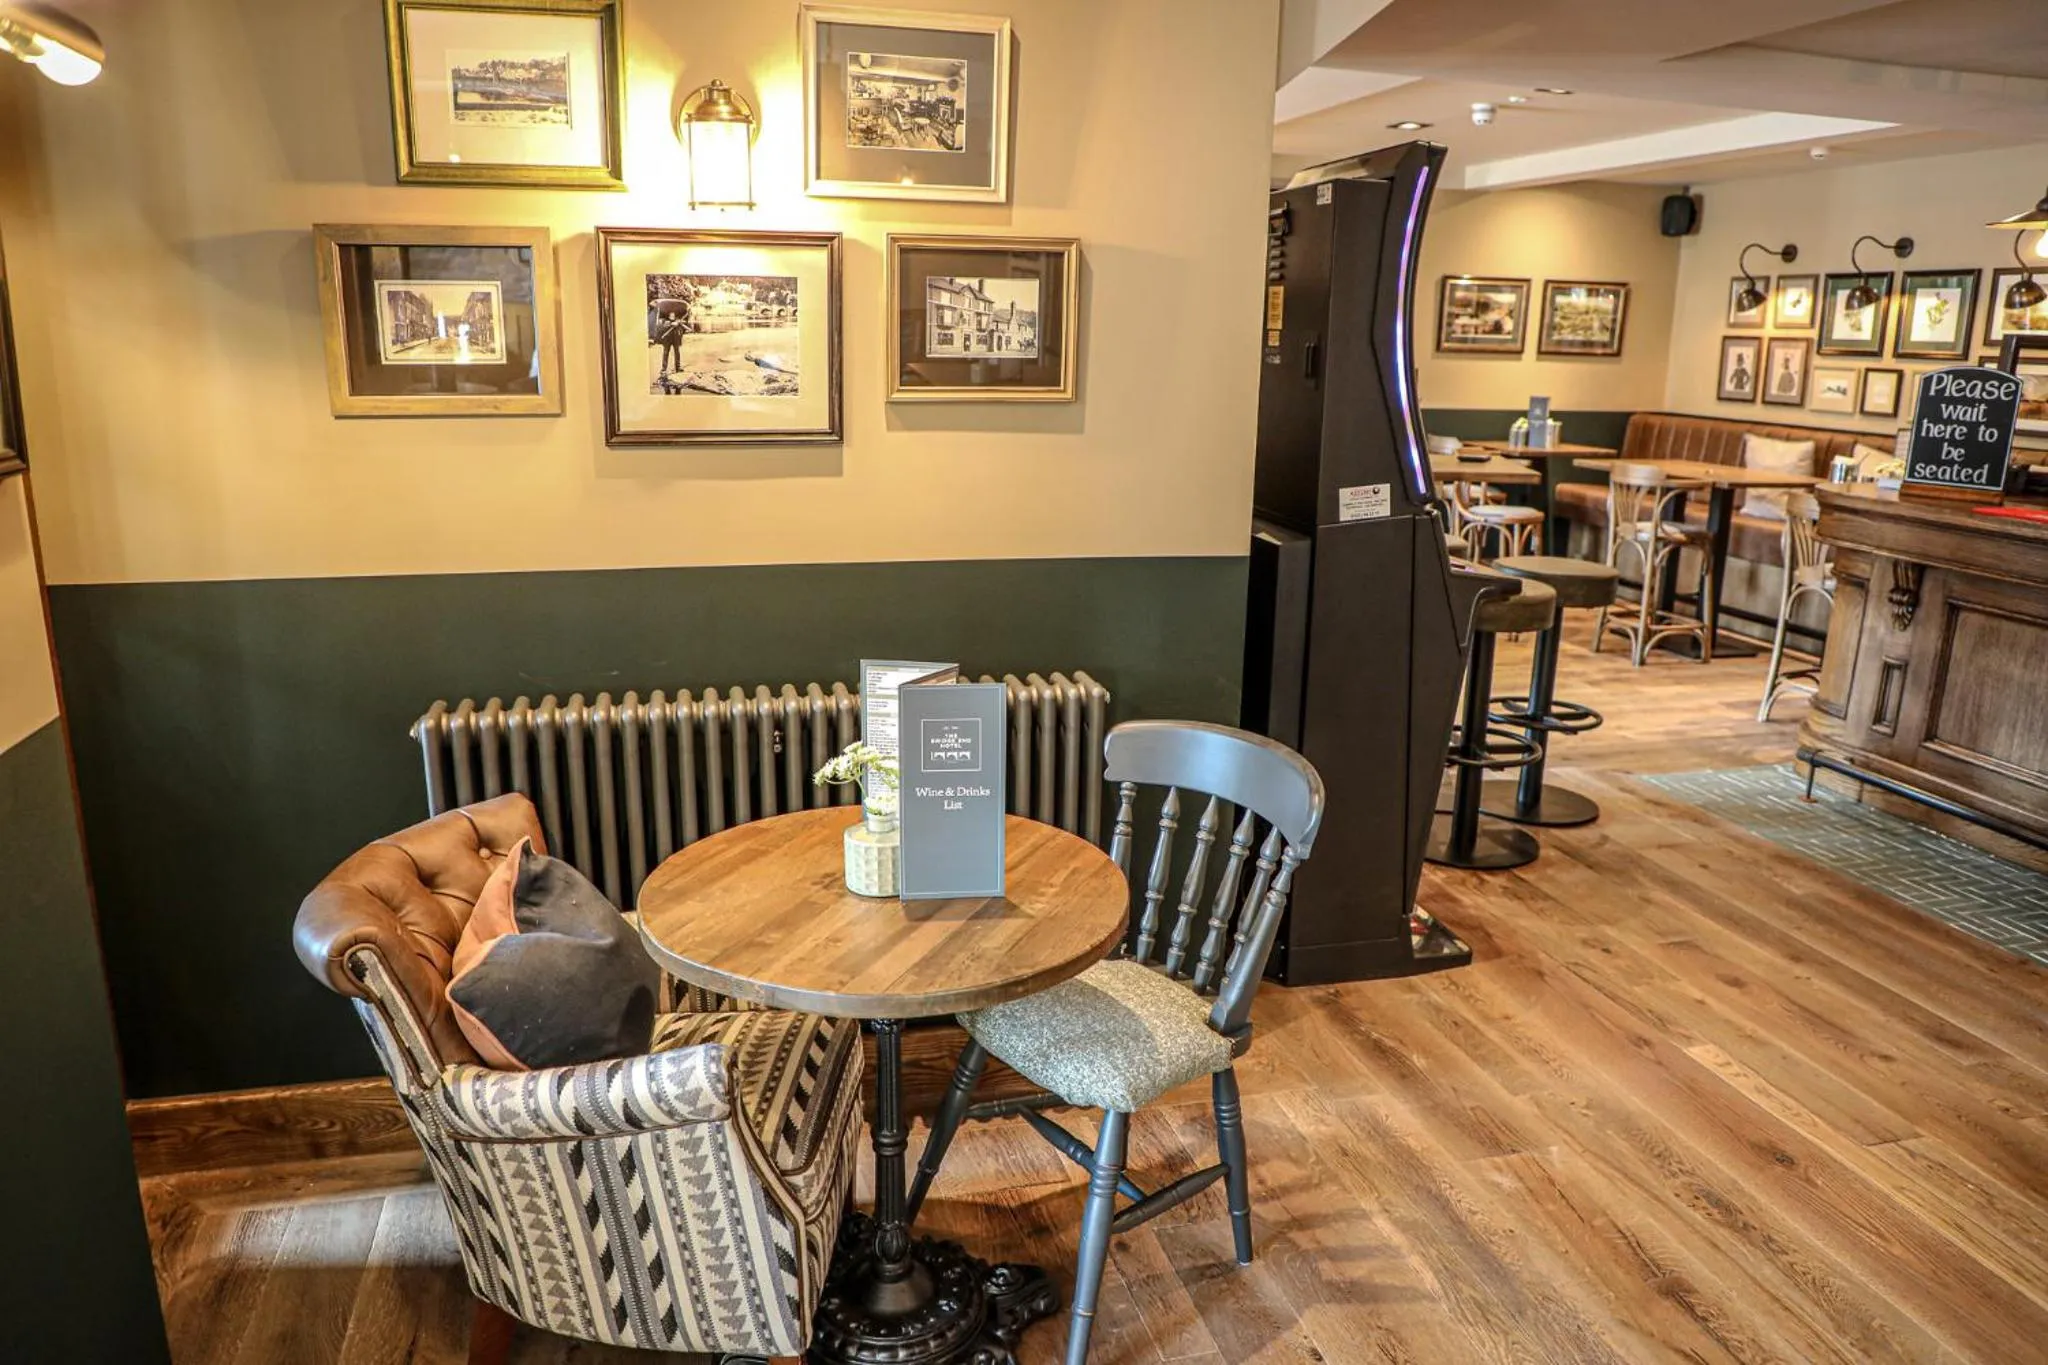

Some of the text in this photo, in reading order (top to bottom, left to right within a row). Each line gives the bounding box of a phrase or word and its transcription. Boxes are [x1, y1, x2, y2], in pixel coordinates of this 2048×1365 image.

[1929, 373, 2016, 401] Please
[1941, 403, 1988, 422] wait
[1921, 418, 1998, 442] here to
[1941, 442, 1966, 461] be
[1914, 463, 1989, 484] seated
[915, 786, 991, 797] Wine & Drinks
[943, 800, 963, 810] List
